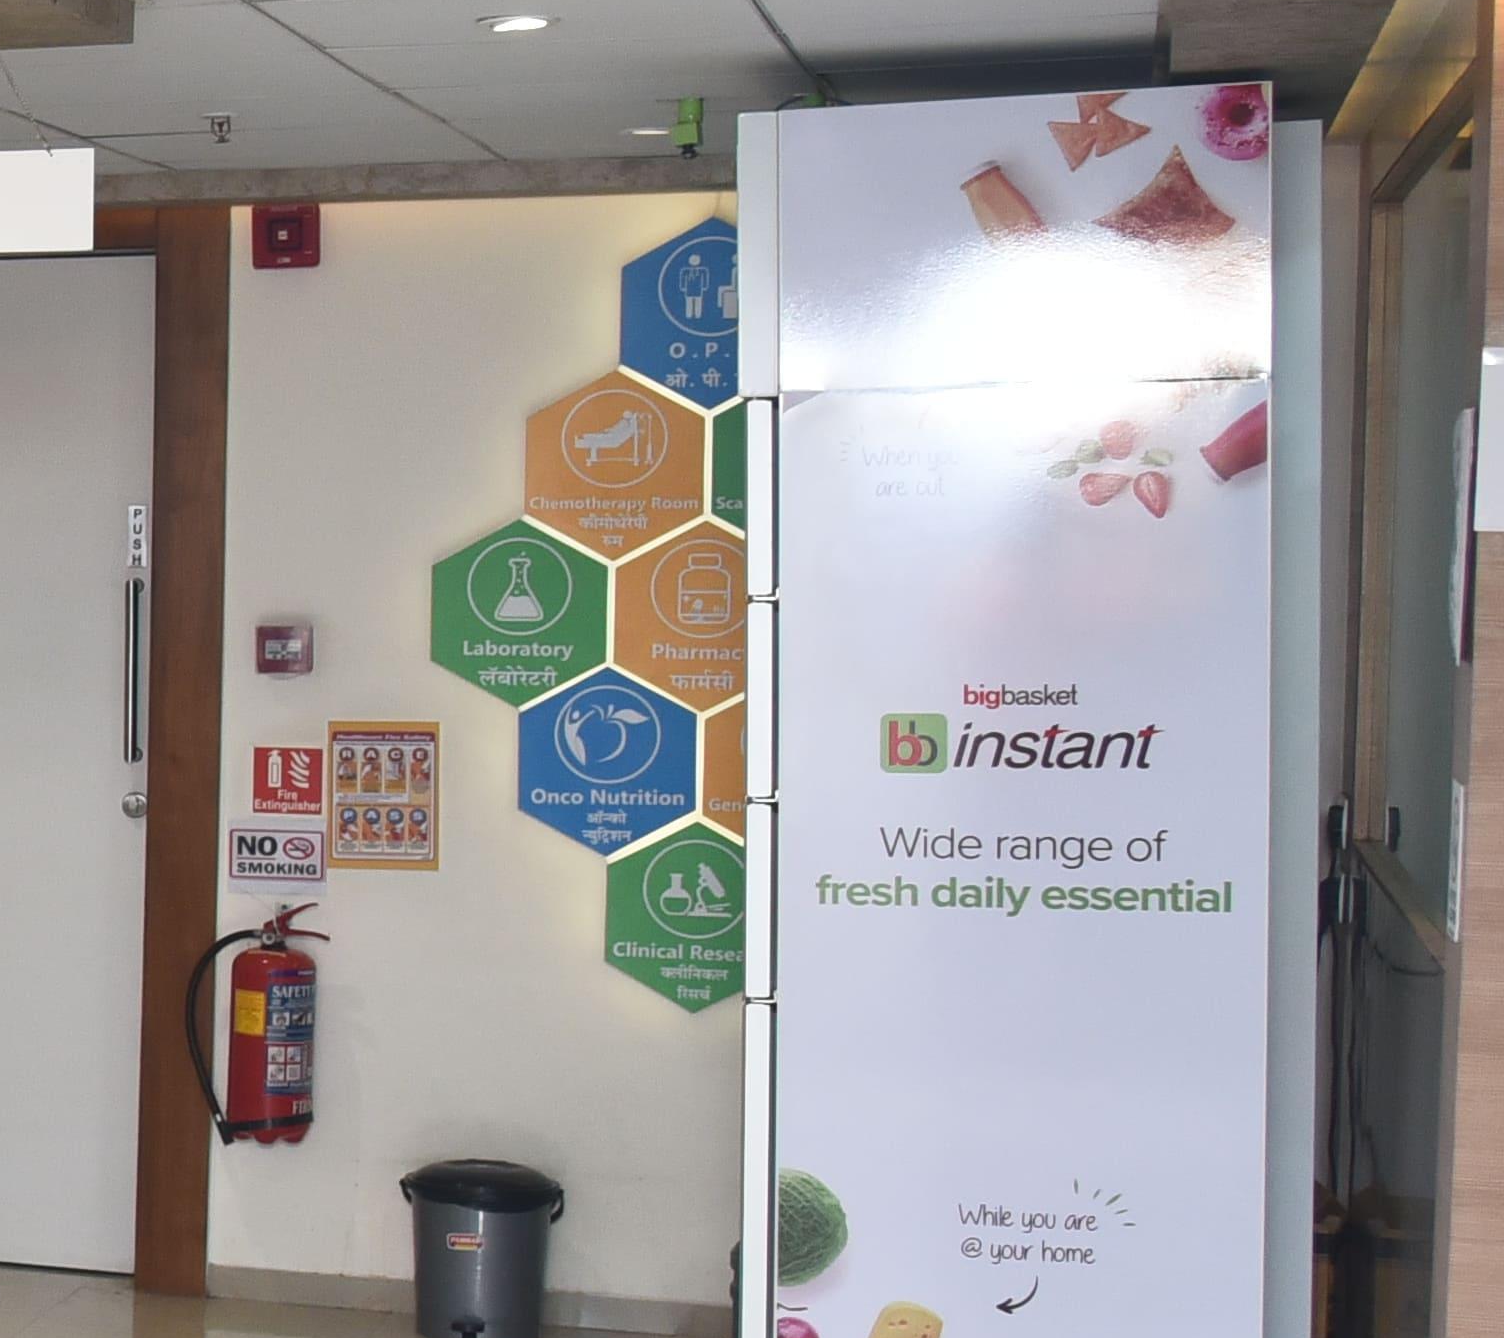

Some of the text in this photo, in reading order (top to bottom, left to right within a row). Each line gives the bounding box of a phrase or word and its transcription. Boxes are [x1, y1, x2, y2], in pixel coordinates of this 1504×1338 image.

[529, 497, 698, 512] Chemotherapy Room
[716, 497, 744, 510] Sca
[132, 509, 143, 567] PUSH
[463, 640, 574, 662] Laboratory
[652, 643, 745, 661] Pharmac
[963, 684, 1078, 709] bigbasket
[953, 721, 1166, 769] instant
[277, 789, 298, 800] Fire
[531, 788, 685, 806] Onco Nutrition
[254, 800, 321, 812] Extinguisher
[237, 836, 278, 856] NO
[880, 827, 1168, 869] Wide range of
[237, 862, 317, 875] SMOKING
[815, 873, 1233, 917] fresh daily essential
[613, 941, 745, 961] Clinical Resea
[958, 1202, 1099, 1234] While you are
[961, 1237, 1096, 1265] @ your home
